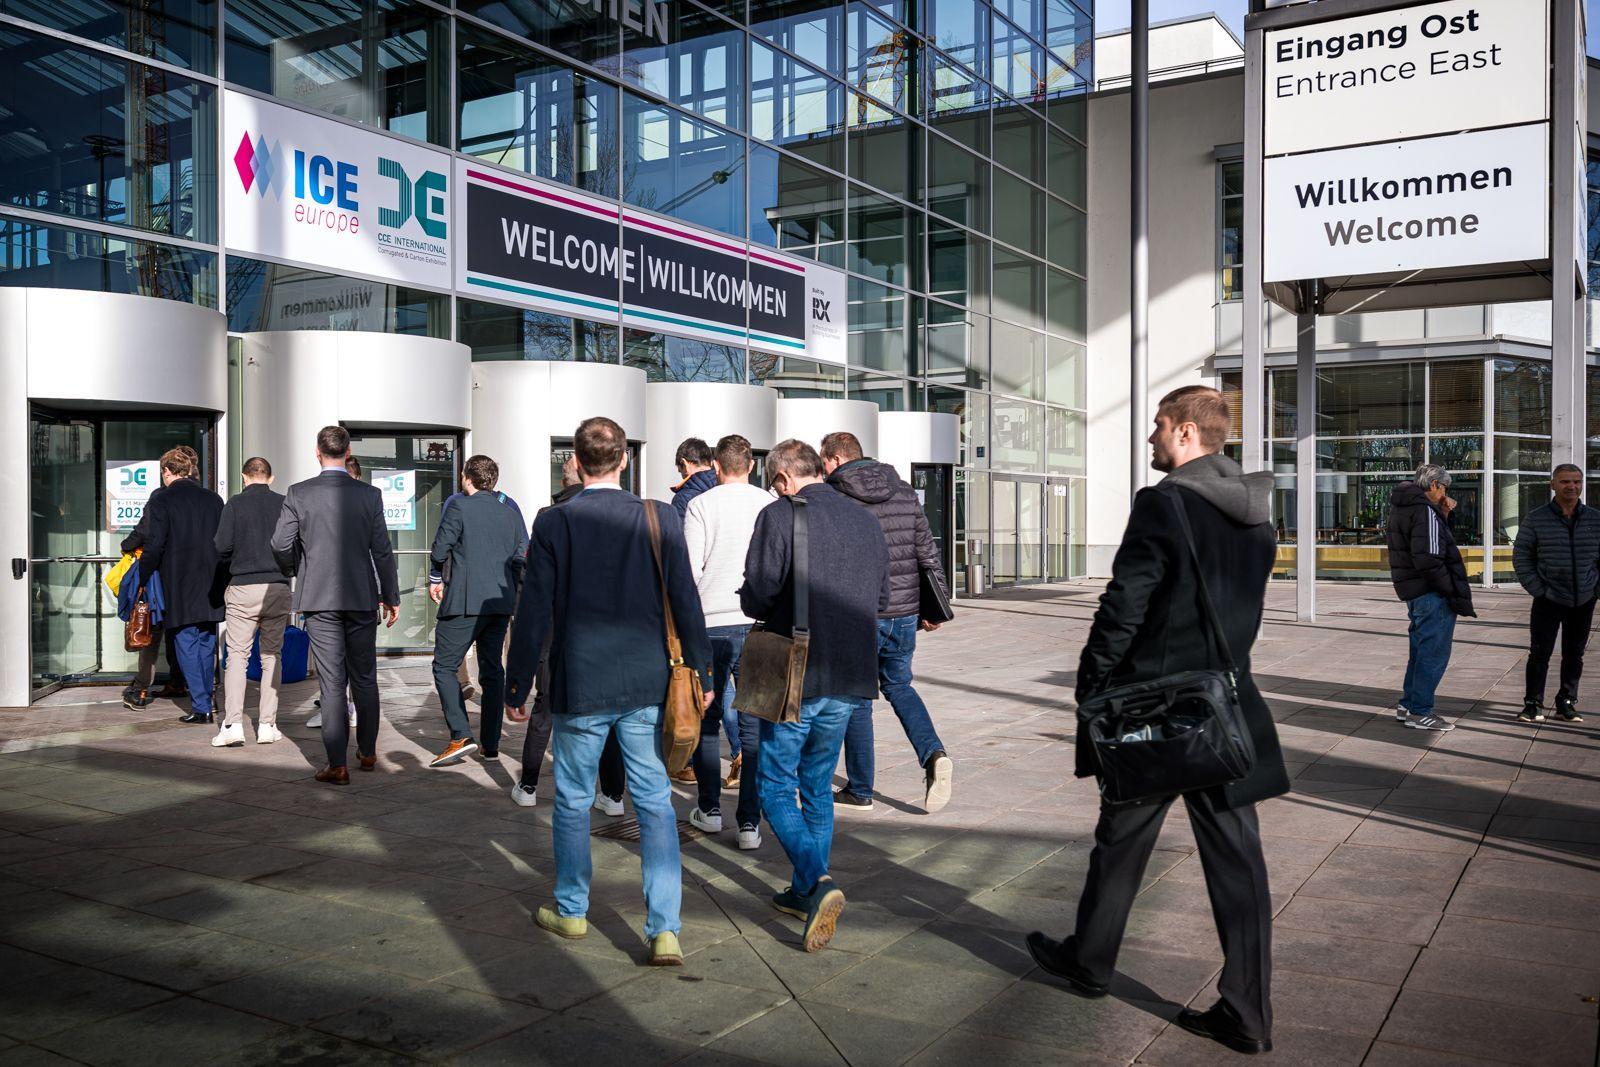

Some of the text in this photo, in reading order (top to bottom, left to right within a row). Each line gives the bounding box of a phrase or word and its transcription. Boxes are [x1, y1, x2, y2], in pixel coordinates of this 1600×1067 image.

[1276, 9, 1480, 63] Eingang Ost
[1276, 43, 1502, 98] Entrance East
[294, 149, 360, 213] ICE
[1294, 165, 1513, 209] Willkommen
[294, 204, 360, 234] europe
[1324, 213, 1480, 247] Welcome
[377, 232, 447, 256] CCE INTERNATIONAL
[501, 217, 787, 318] WELCOME WILLKOMMEN
[812, 297, 831, 323] RX
[117, 507, 141, 518] 202
